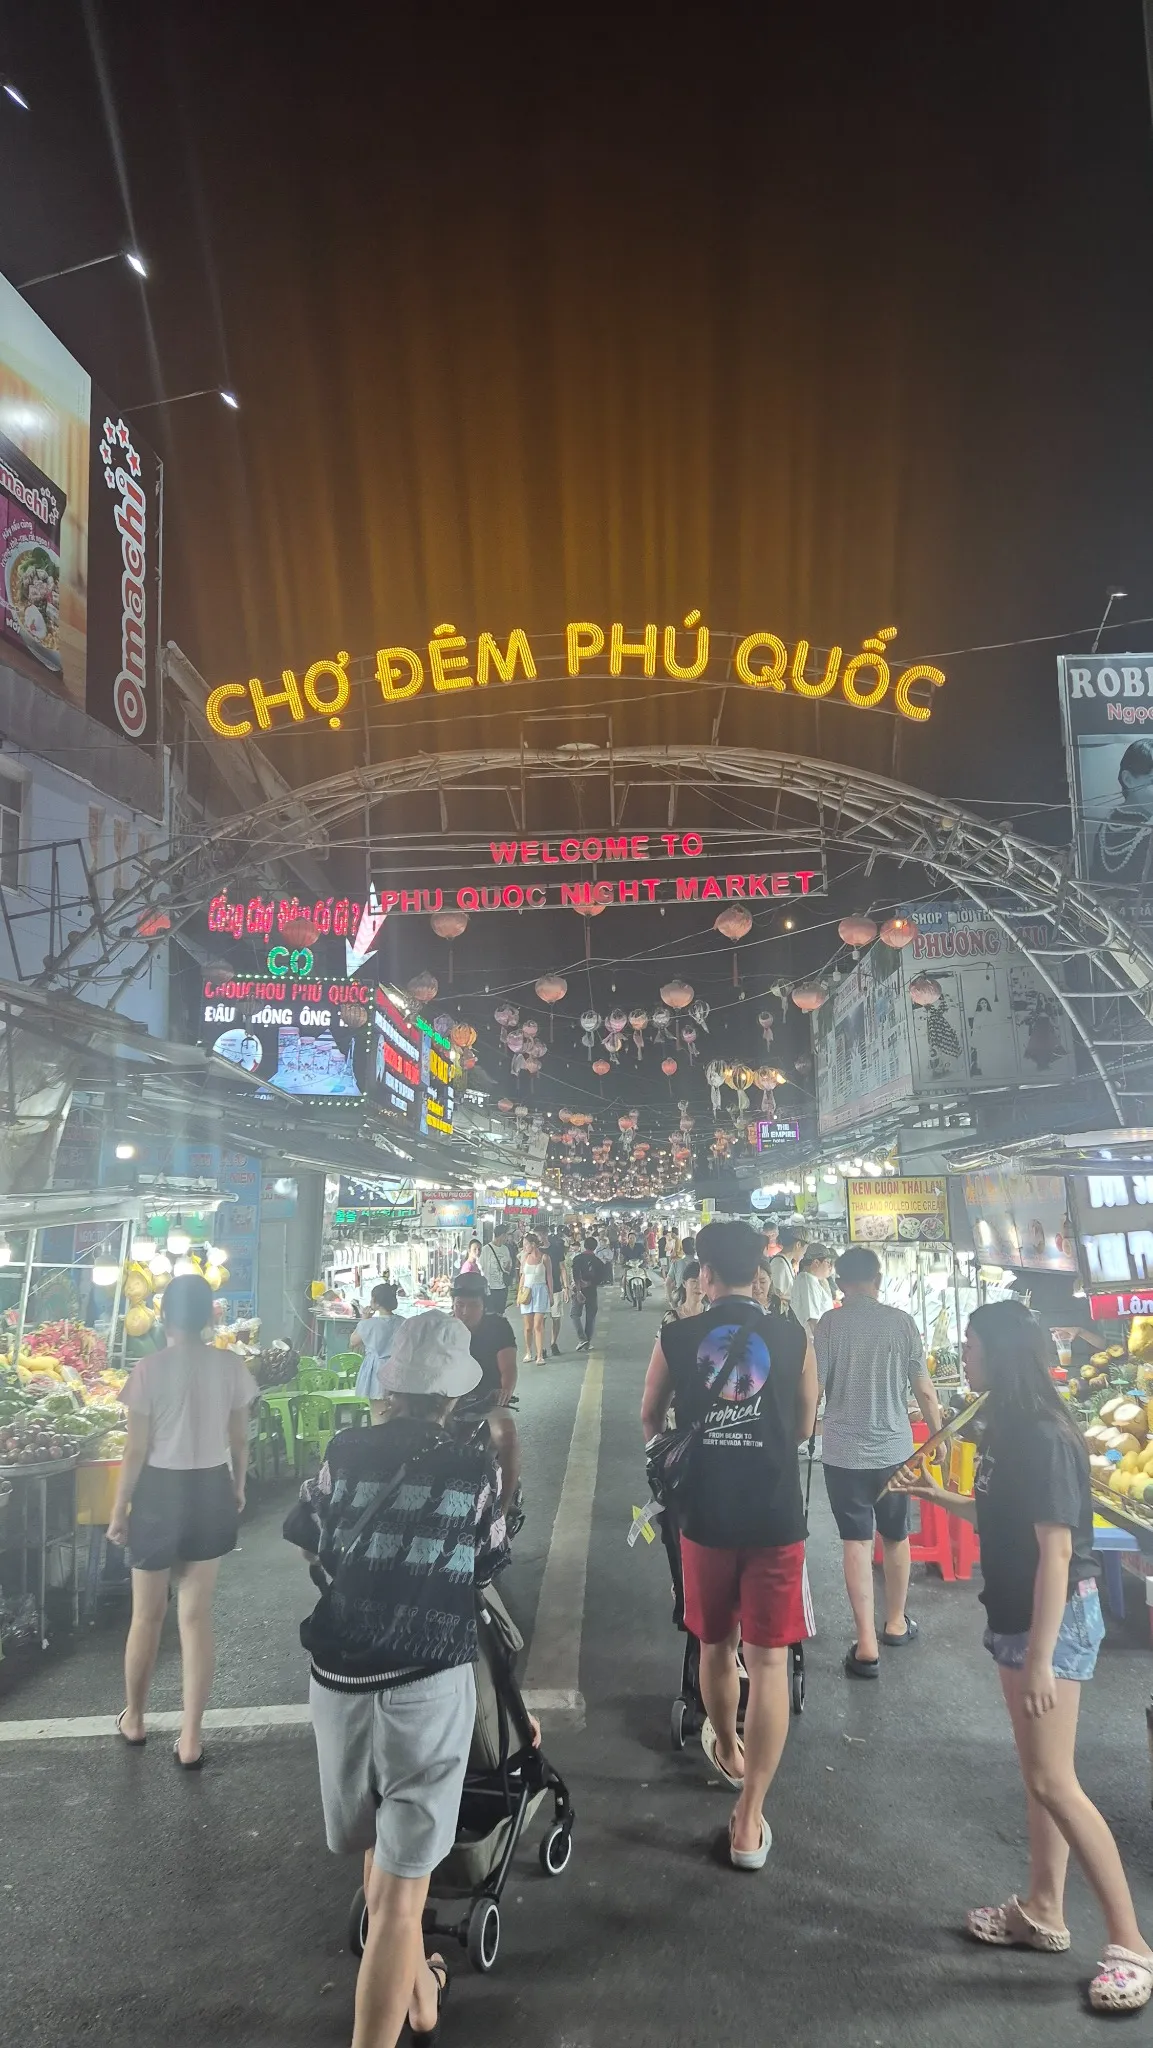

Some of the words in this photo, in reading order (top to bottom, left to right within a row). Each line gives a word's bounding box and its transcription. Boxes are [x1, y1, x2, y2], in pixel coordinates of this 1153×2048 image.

[113, 467, 146, 738] Omachi
[206, 650, 351, 740] CHỢ
[374, 623, 537, 701] ĐÊM
[566, 609, 710, 680] PHÚ
[736, 625, 946, 722] QUỐC
[491, 834, 650, 865] WELCOME
[661, 832, 704, 858] TO
[381, 889, 442, 912] PHU
[457, 884, 547, 912] QUOC
[561, 879, 661, 906] NIGHT
[677, 871, 815, 901] MARKET
[912, 912, 942, 925] SHOP
[912, 924, 1000, 960] PHƯƠNG
[300, 1005, 332, 1027] ÔNG
[852, 1181, 872, 1196] KEM
[874, 1179, 899, 1197] CUỘN
[902, 1178, 923, 1195] THÁI
[852, 1201, 882, 1211] THAILAND
[884, 1201, 909, 1211] ROLLED
[910, 1201, 921, 1211] ICE
